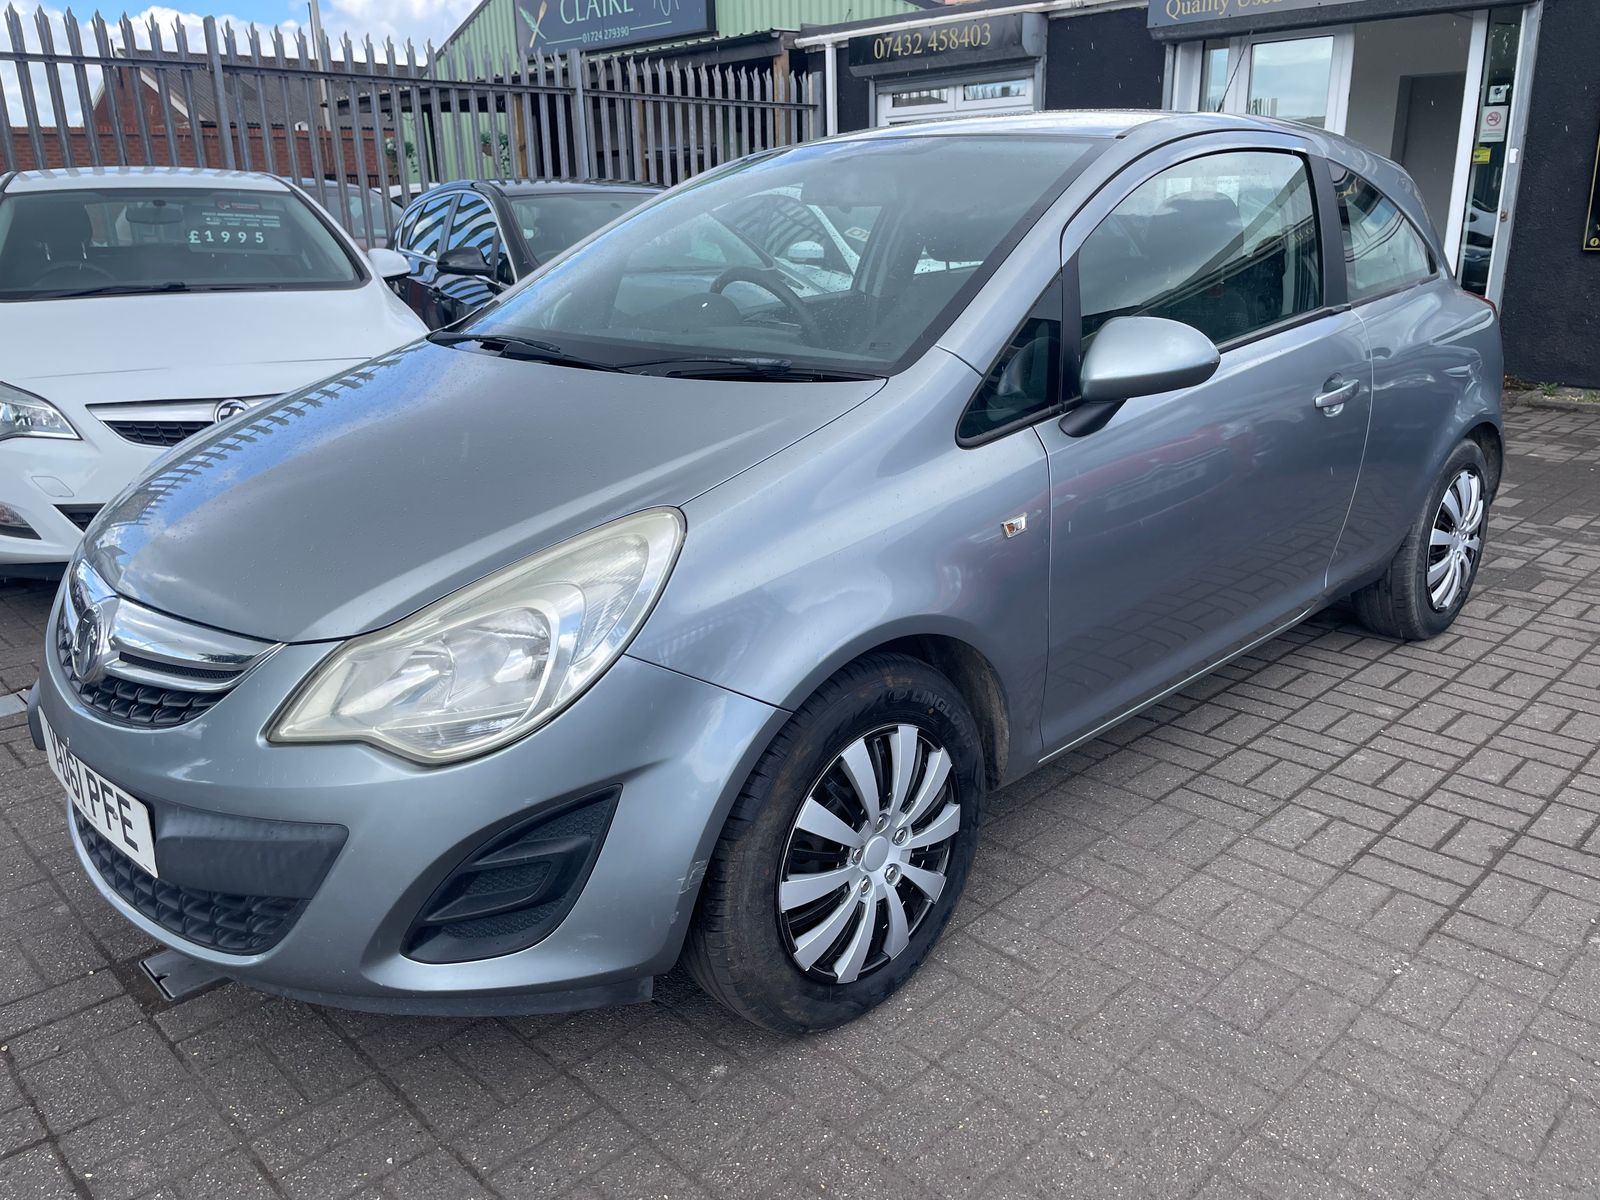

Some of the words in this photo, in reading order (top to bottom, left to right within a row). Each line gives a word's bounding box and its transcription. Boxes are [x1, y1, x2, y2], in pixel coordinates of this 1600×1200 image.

[1166, 0, 1228, 20] Quality
[582, 31, 603, 43] 01724
[604, 26, 630, 40] 279390
[874, 33, 922, 59] 07432
[928, 23, 991, 52] 458403
[188, 230, 264, 244] £1995
[85, 768, 139, 852] PFE
